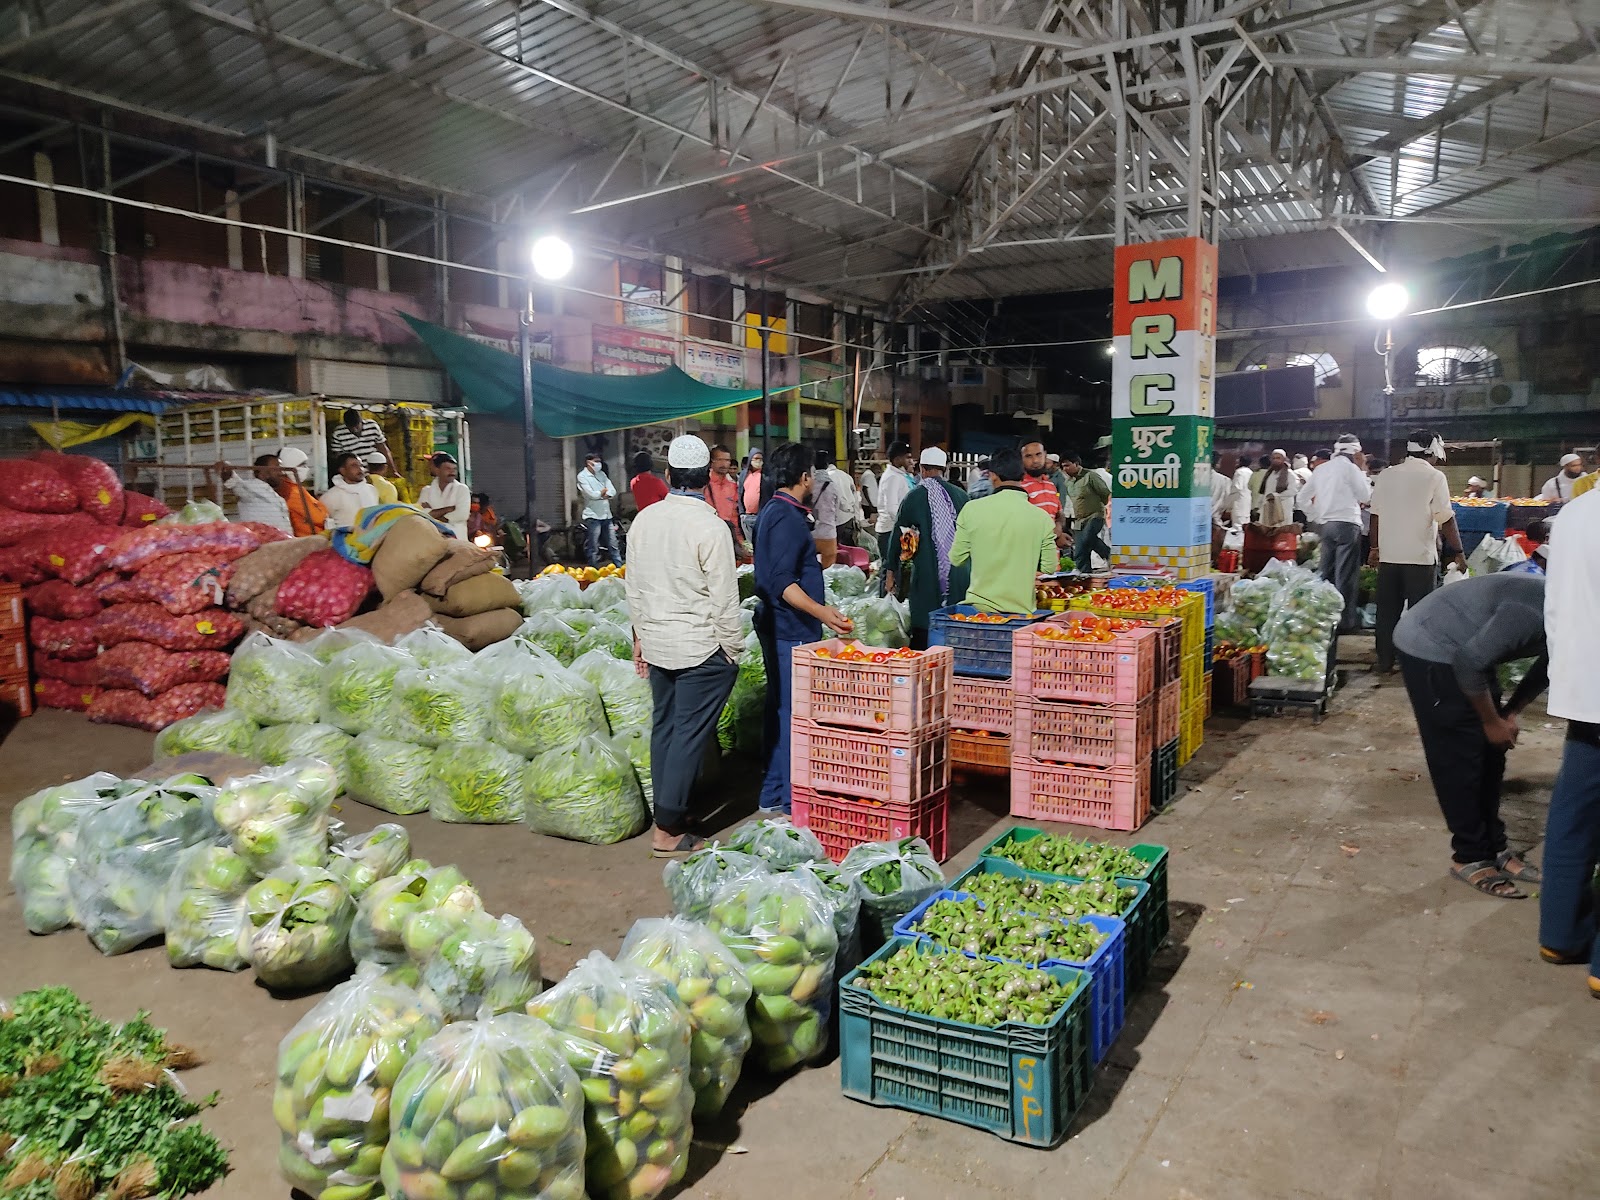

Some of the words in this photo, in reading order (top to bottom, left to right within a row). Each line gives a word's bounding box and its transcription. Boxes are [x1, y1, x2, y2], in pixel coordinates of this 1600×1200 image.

[1129, 256, 1183, 416] MRC
[1130, 425, 1175, 458] फ्रुट
[1118, 453, 1182, 489] कंपनी
